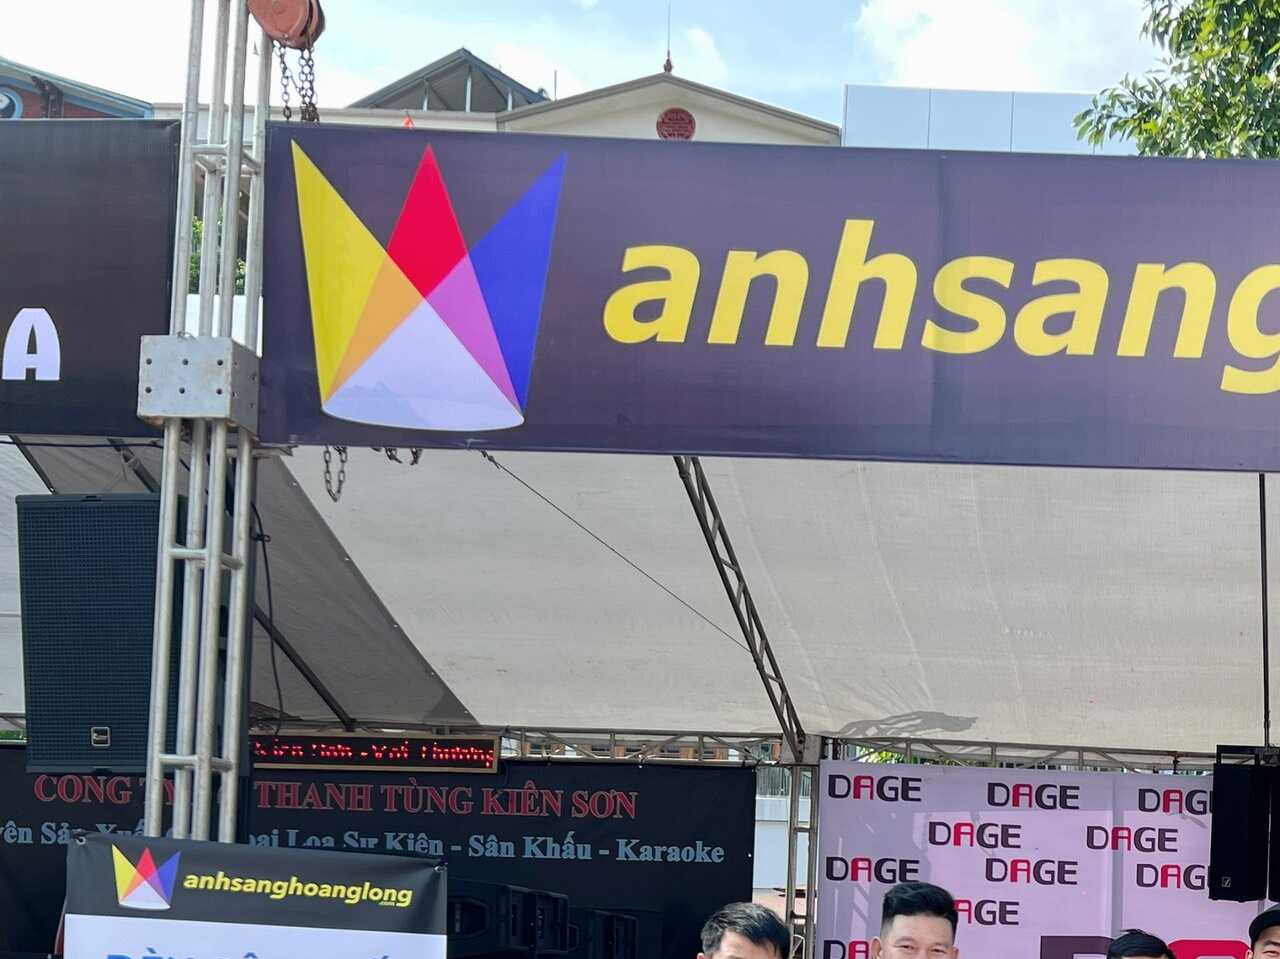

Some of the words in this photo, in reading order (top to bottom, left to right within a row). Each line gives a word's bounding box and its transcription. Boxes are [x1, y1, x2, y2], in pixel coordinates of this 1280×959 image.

[254, 781, 374, 811] THANH
[481, 780, 564, 817] KIÊN
[571, 787, 638, 819] SƠN
[828, 774, 921, 802] DAGE
[987, 782, 1080, 810] DAGE
[1138, 789, 1212, 816] DAG
[1, 820, 33, 844] ên
[468, 834, 516, 858] Sân
[523, 831, 592, 860] Khấu
[615, 838, 725, 863] Karaoke
[928, 821, 1022, 849] DAGE
[1086, 825, 1178, 853] DAGE
[825, 856, 920, 884] DAGE
[985, 857, 1078, 886] DAGE
[1136, 863, 1209, 890] DAG
[183, 870, 413, 907] anhsanghoanglong
[954, 899, 1019, 925] AGE
